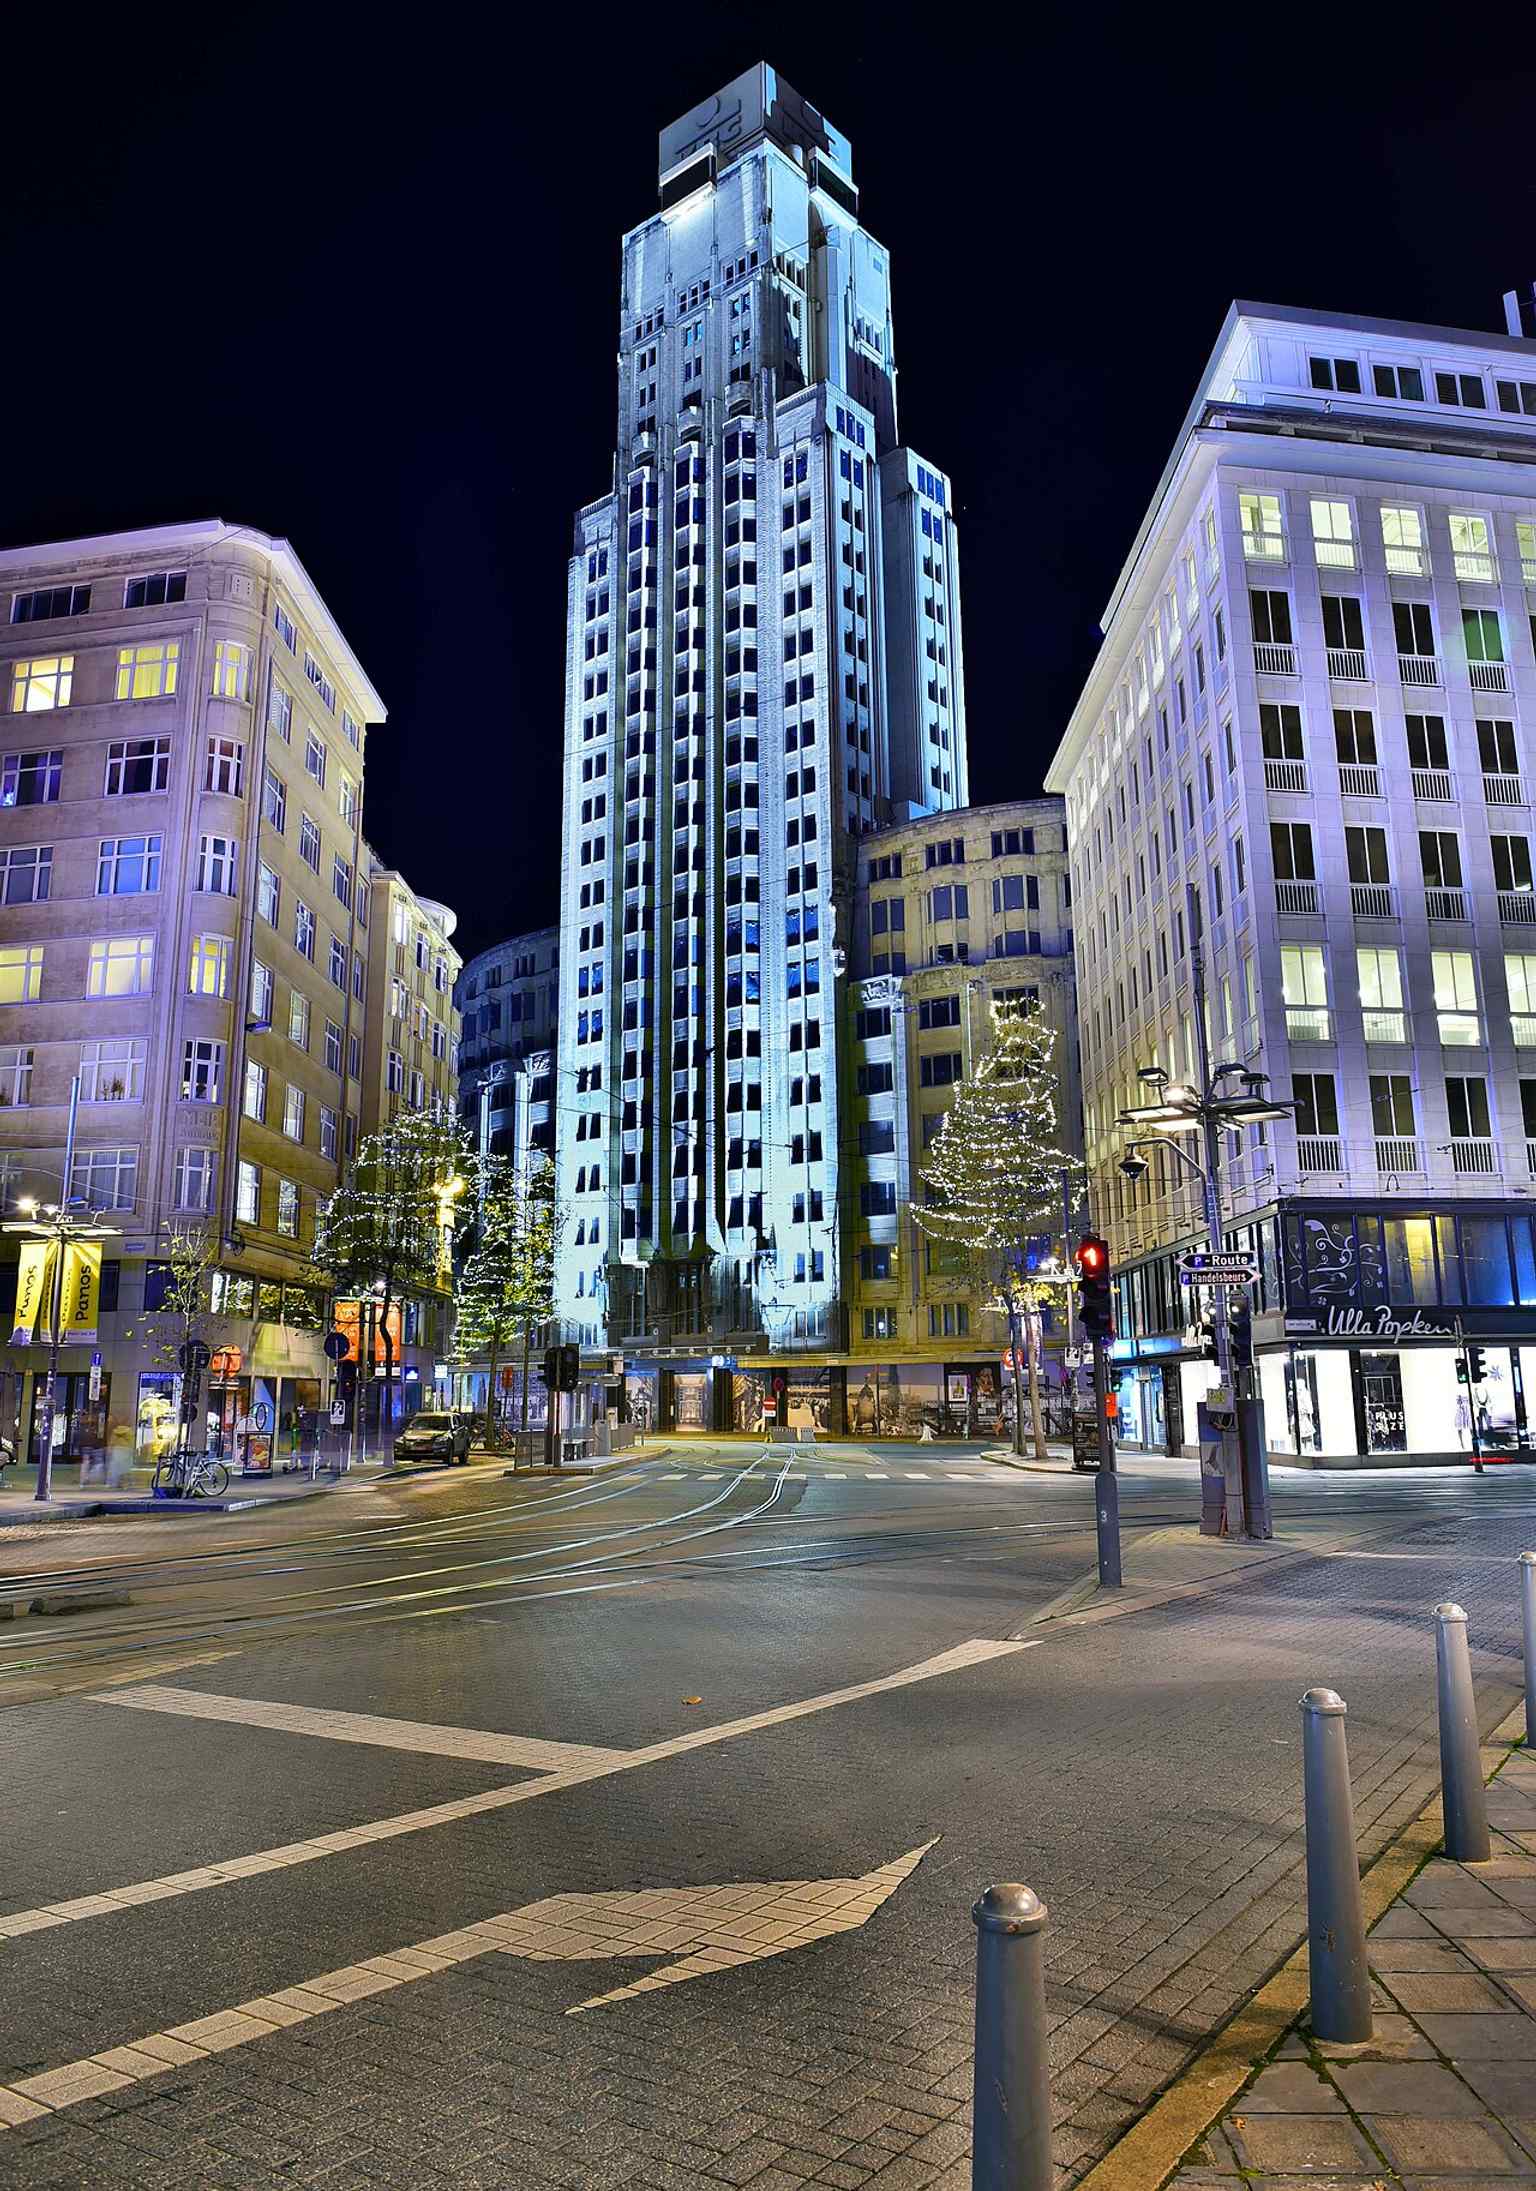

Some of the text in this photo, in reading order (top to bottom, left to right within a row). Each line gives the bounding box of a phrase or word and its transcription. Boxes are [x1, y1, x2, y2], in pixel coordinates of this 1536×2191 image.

[74, 1264, 92, 1321] Panos
[1328, 1304, 1451, 1344] Ulla Popken
